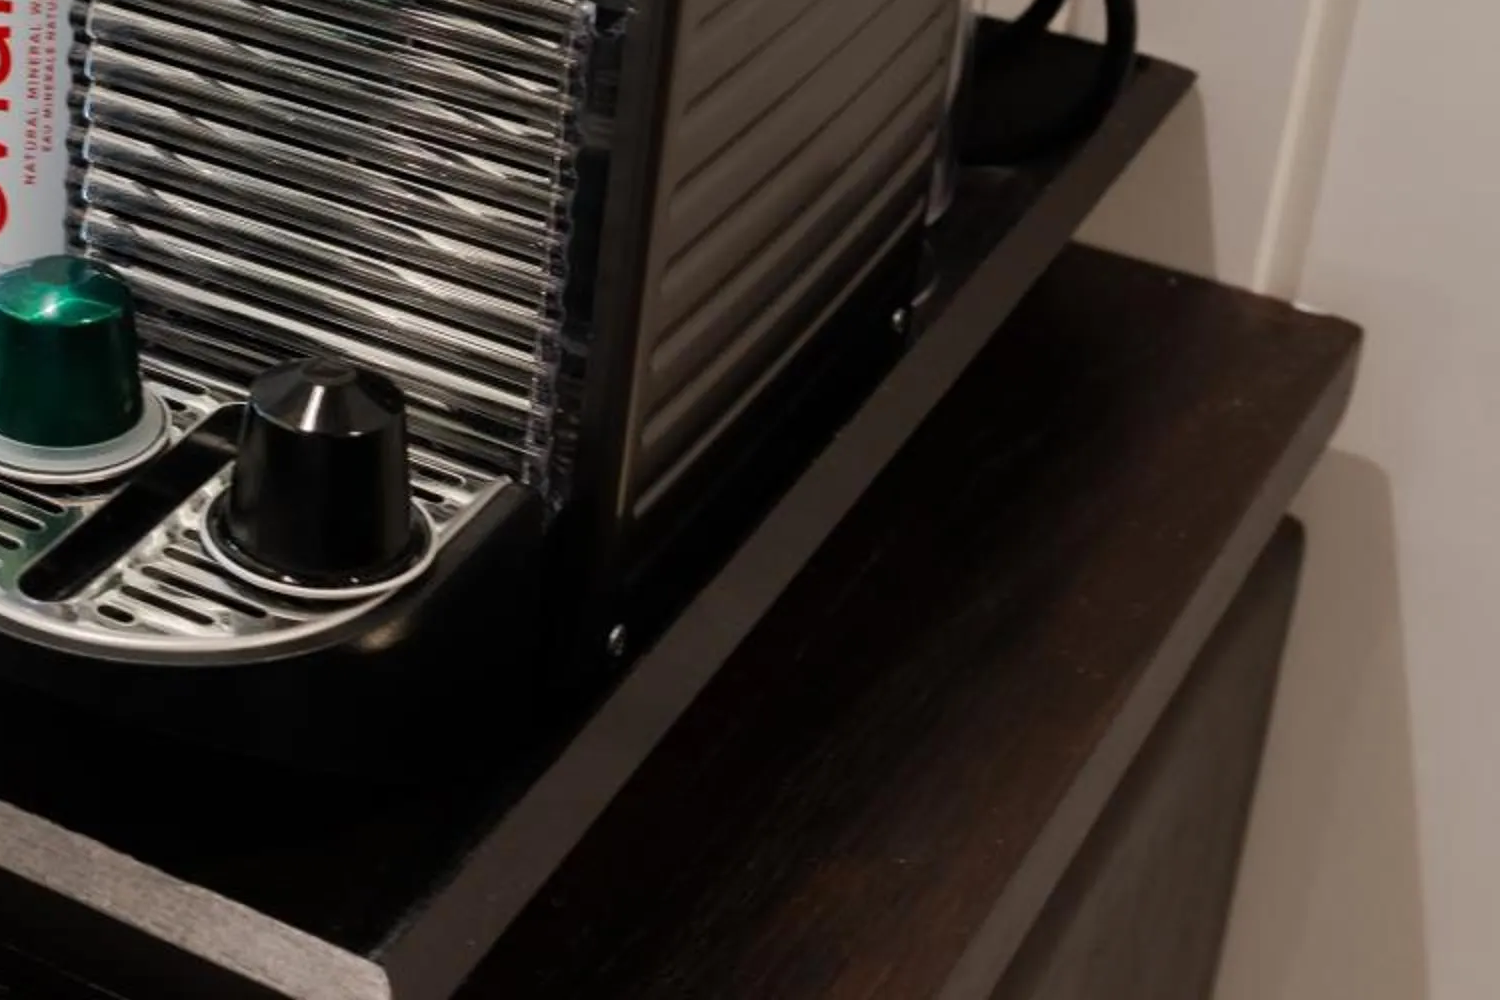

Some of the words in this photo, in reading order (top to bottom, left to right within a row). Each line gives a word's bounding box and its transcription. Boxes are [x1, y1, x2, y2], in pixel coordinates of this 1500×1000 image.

[26, 25, 41, 101] MINERAL
[23, 109, 39, 186] NATURAL
[42, 124, 53, 153] EAU
